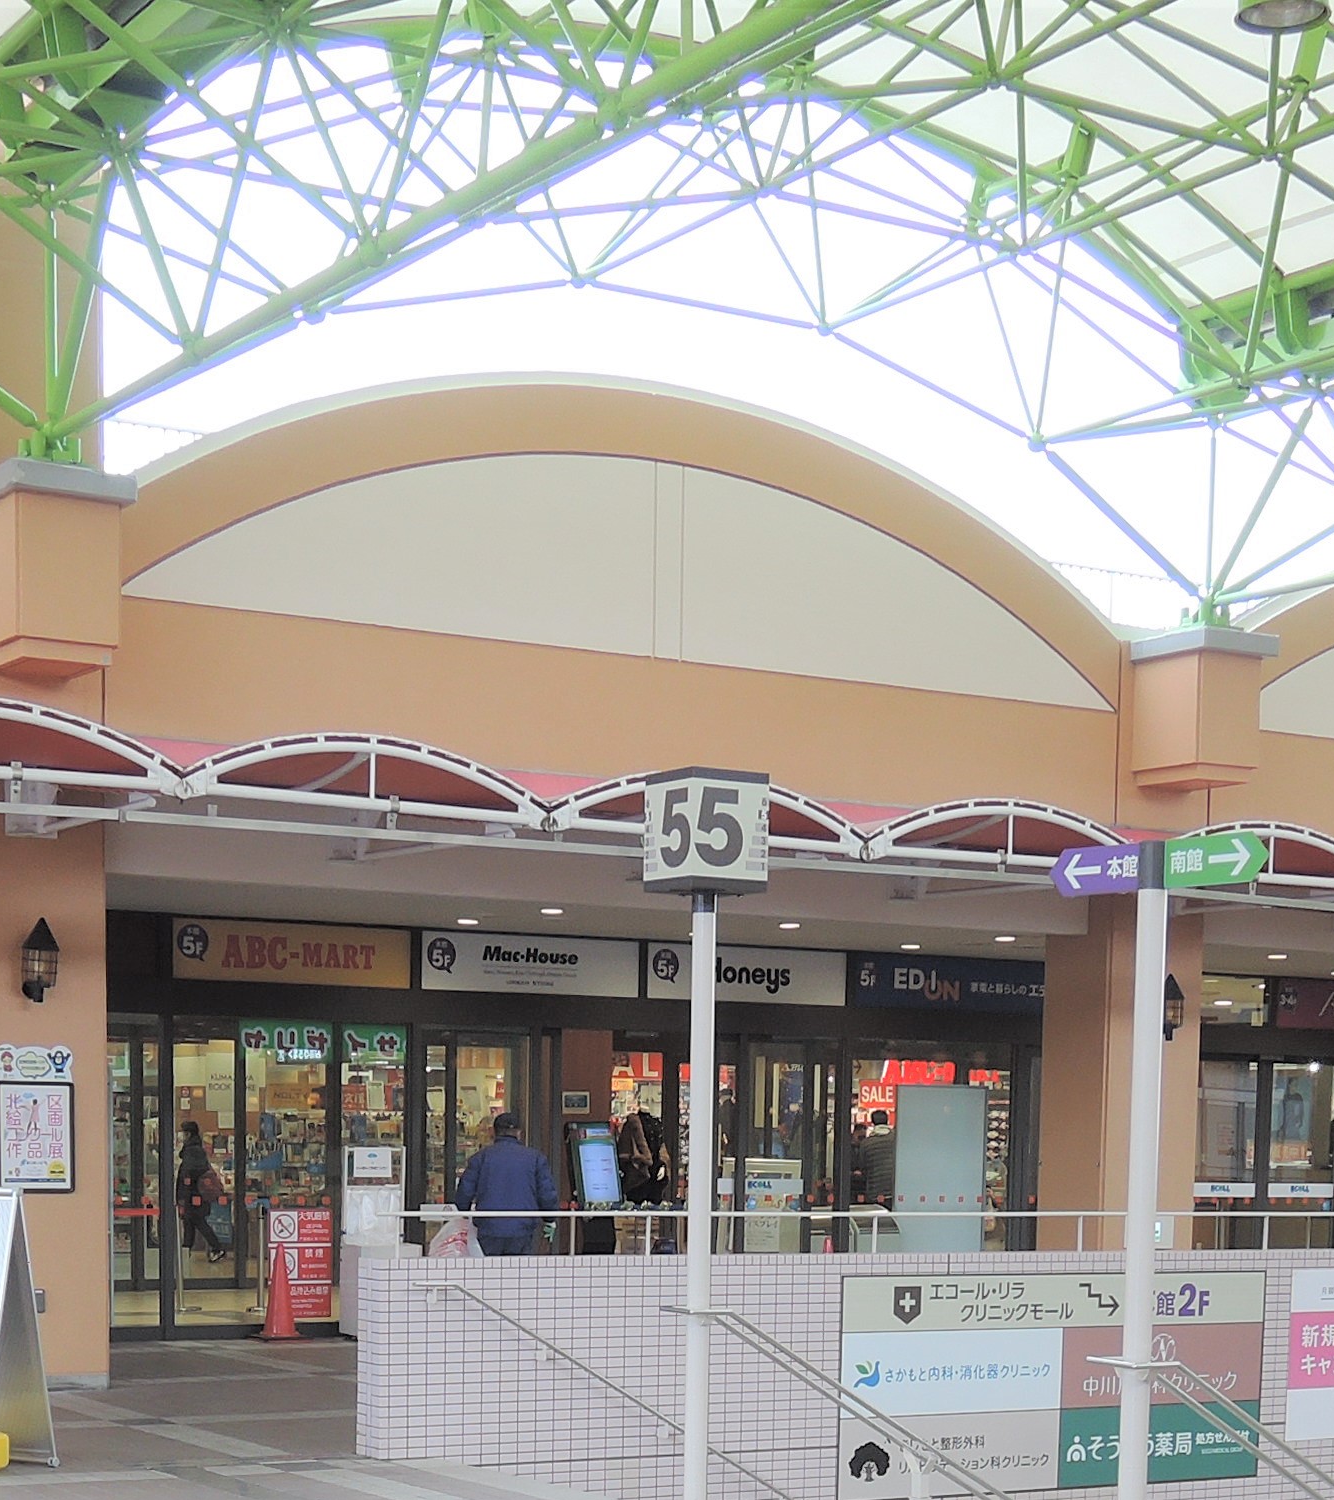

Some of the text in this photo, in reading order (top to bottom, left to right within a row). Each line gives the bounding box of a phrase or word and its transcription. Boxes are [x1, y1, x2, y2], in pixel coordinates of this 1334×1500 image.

[1106, 854, 1139, 879] 本館
[1170, 848, 1204, 875] 南館
[182, 936, 204, 956] 5F
[222, 934, 376, 970] ABC-MART
[431, 949, 452, 968] 5F
[893, 967, 961, 1001] EDION
[861, 1085, 894, 1104] SALE
[929, 1282, 1025, 1301] エコール・リラ
[960, 1302, 1075, 1323] クリニックモール
[884, 1363, 1051, 1384] さかもと内科・消化器クリニック
